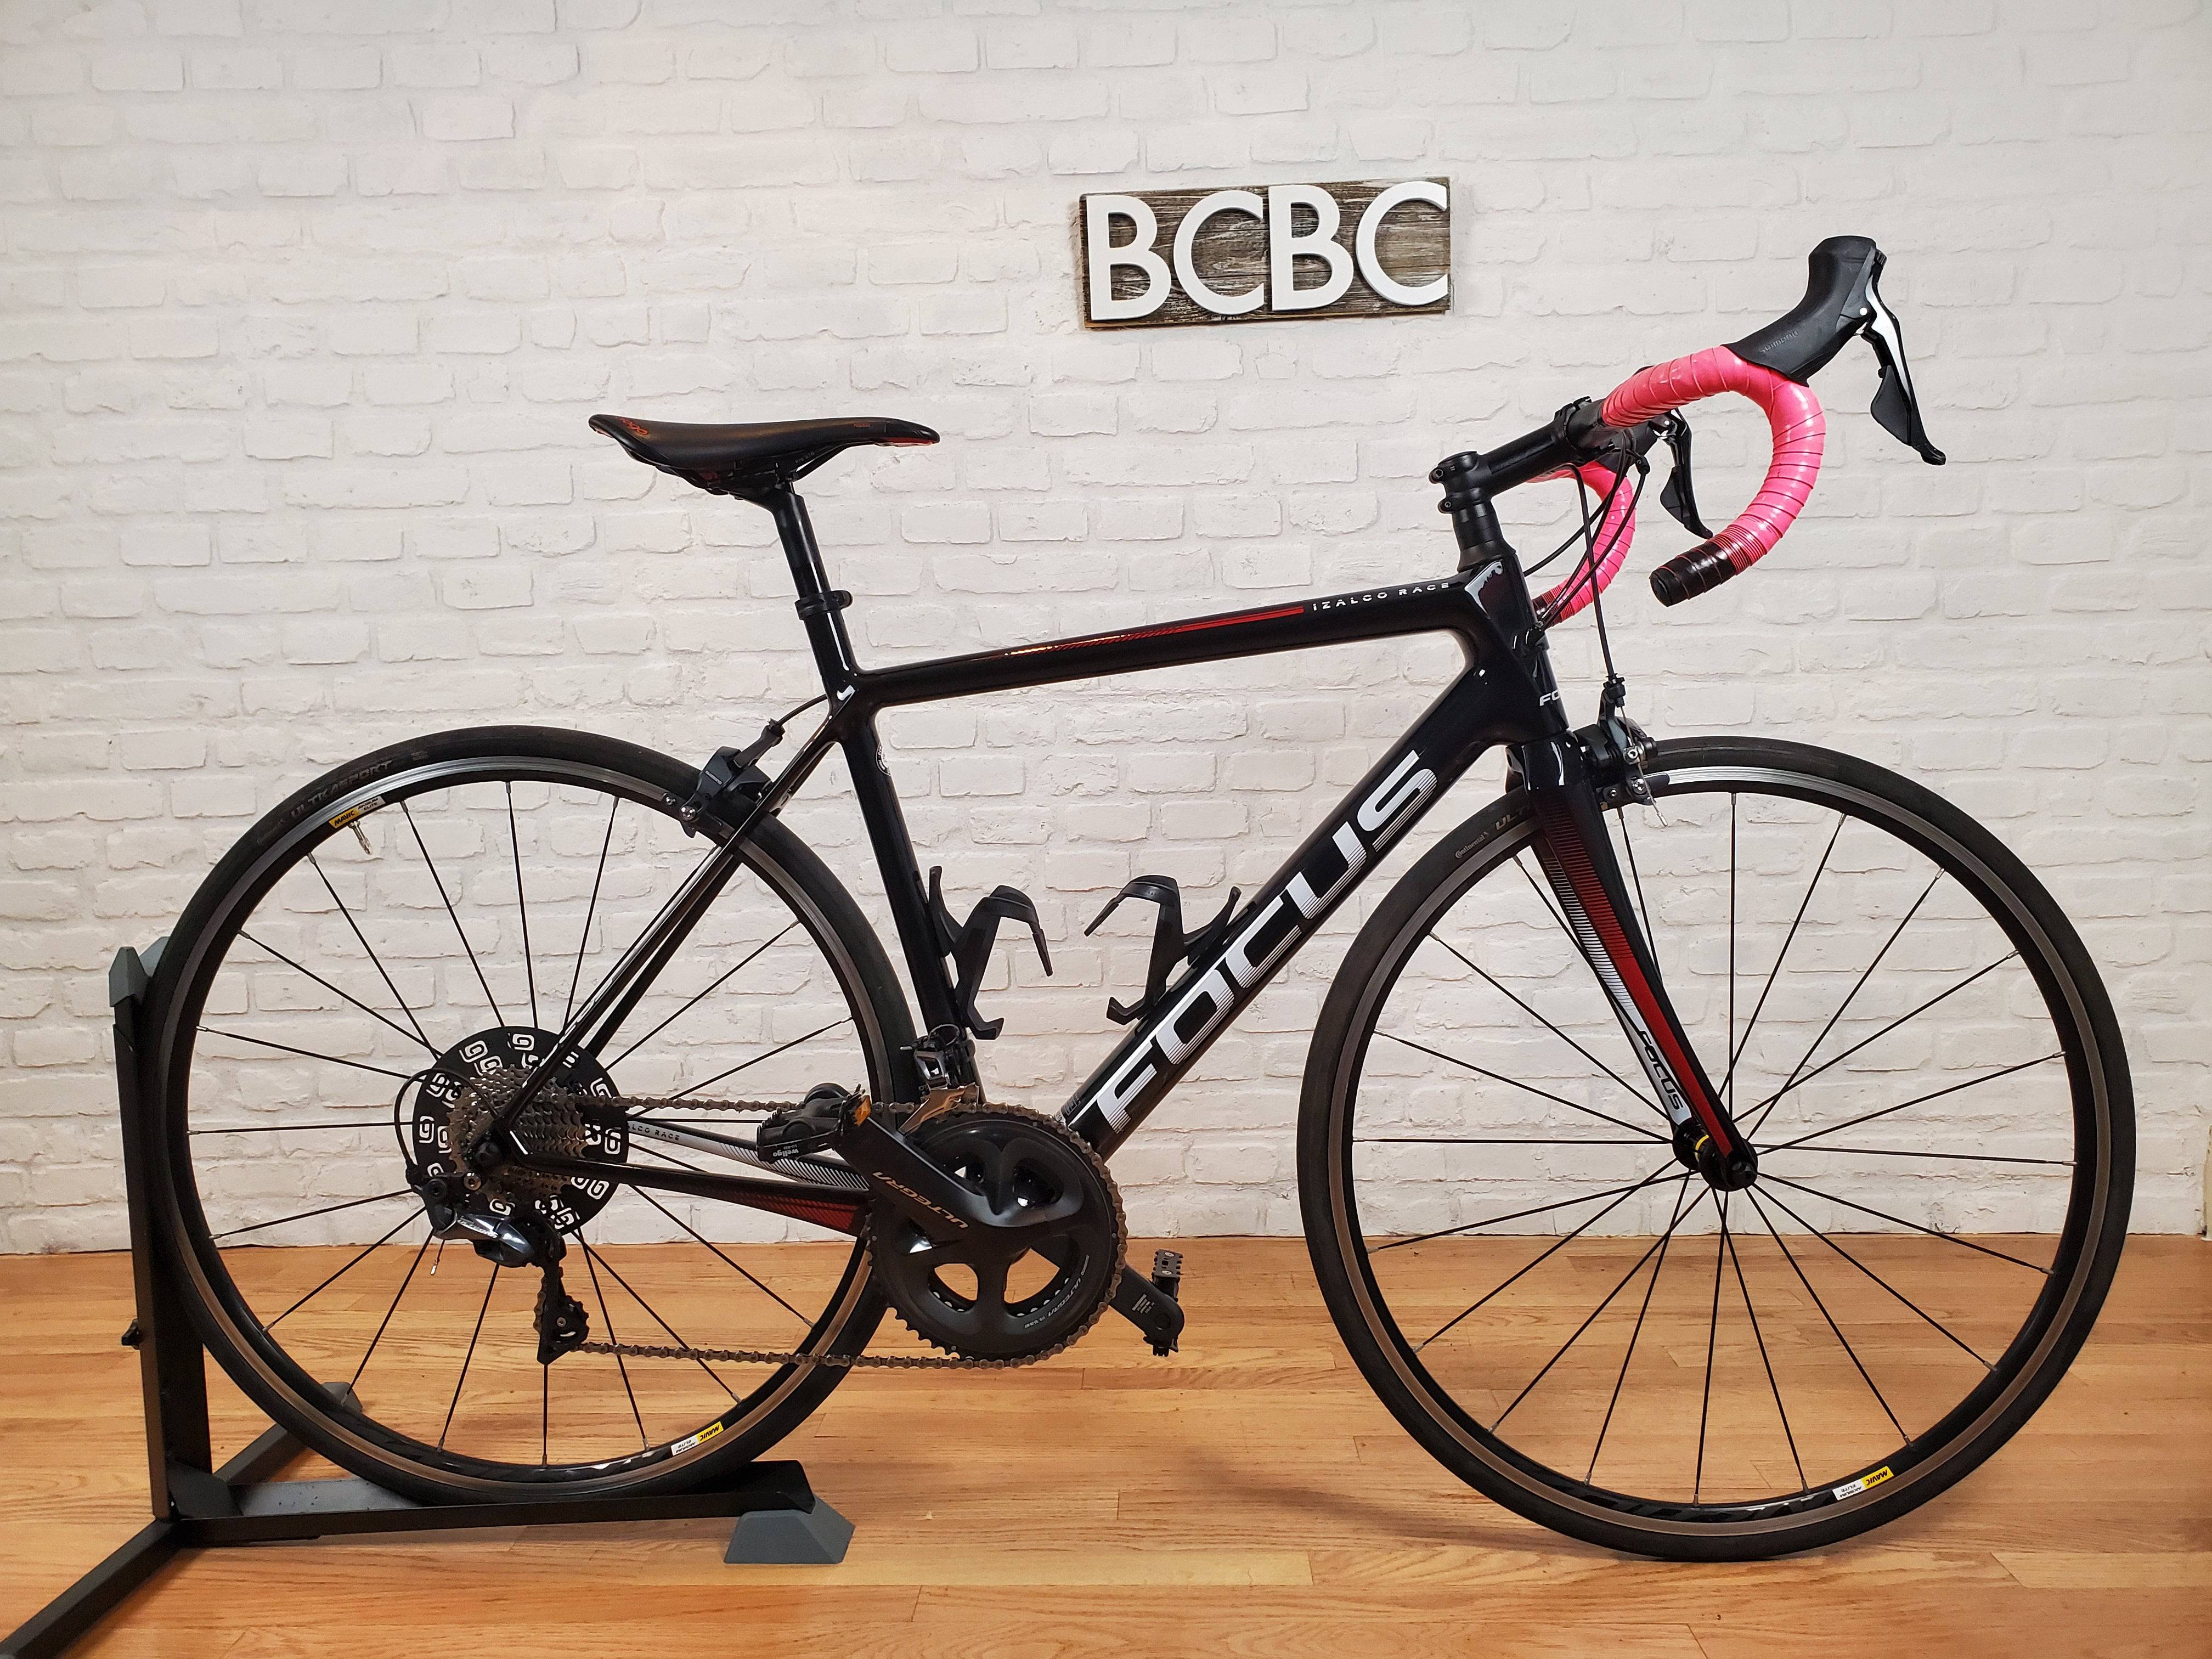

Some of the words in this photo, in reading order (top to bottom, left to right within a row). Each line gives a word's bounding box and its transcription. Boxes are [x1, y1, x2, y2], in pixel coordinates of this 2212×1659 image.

[1086, 180, 1448, 321] BCBC
[1313, 592, 1388, 611] IZALCO
[1398, 582, 1449, 596] RACE
[363, 802, 379, 811] ELITE
[334, 810, 356, 826] MAVIC
[1097, 749, 1437, 1134] FOCUS
[1639, 1030, 1684, 1110] FOCUS
[654, 1130, 680, 1141] RACE
[772, 1148, 799, 1157] wellgo
[872, 1171, 969, 1229] ULTEGRA
[699, 1425, 720, 1442] MAVIC
[1865, 1469, 1888, 1486] MAVIC
[1841, 1484, 1856, 1493] ELITE
